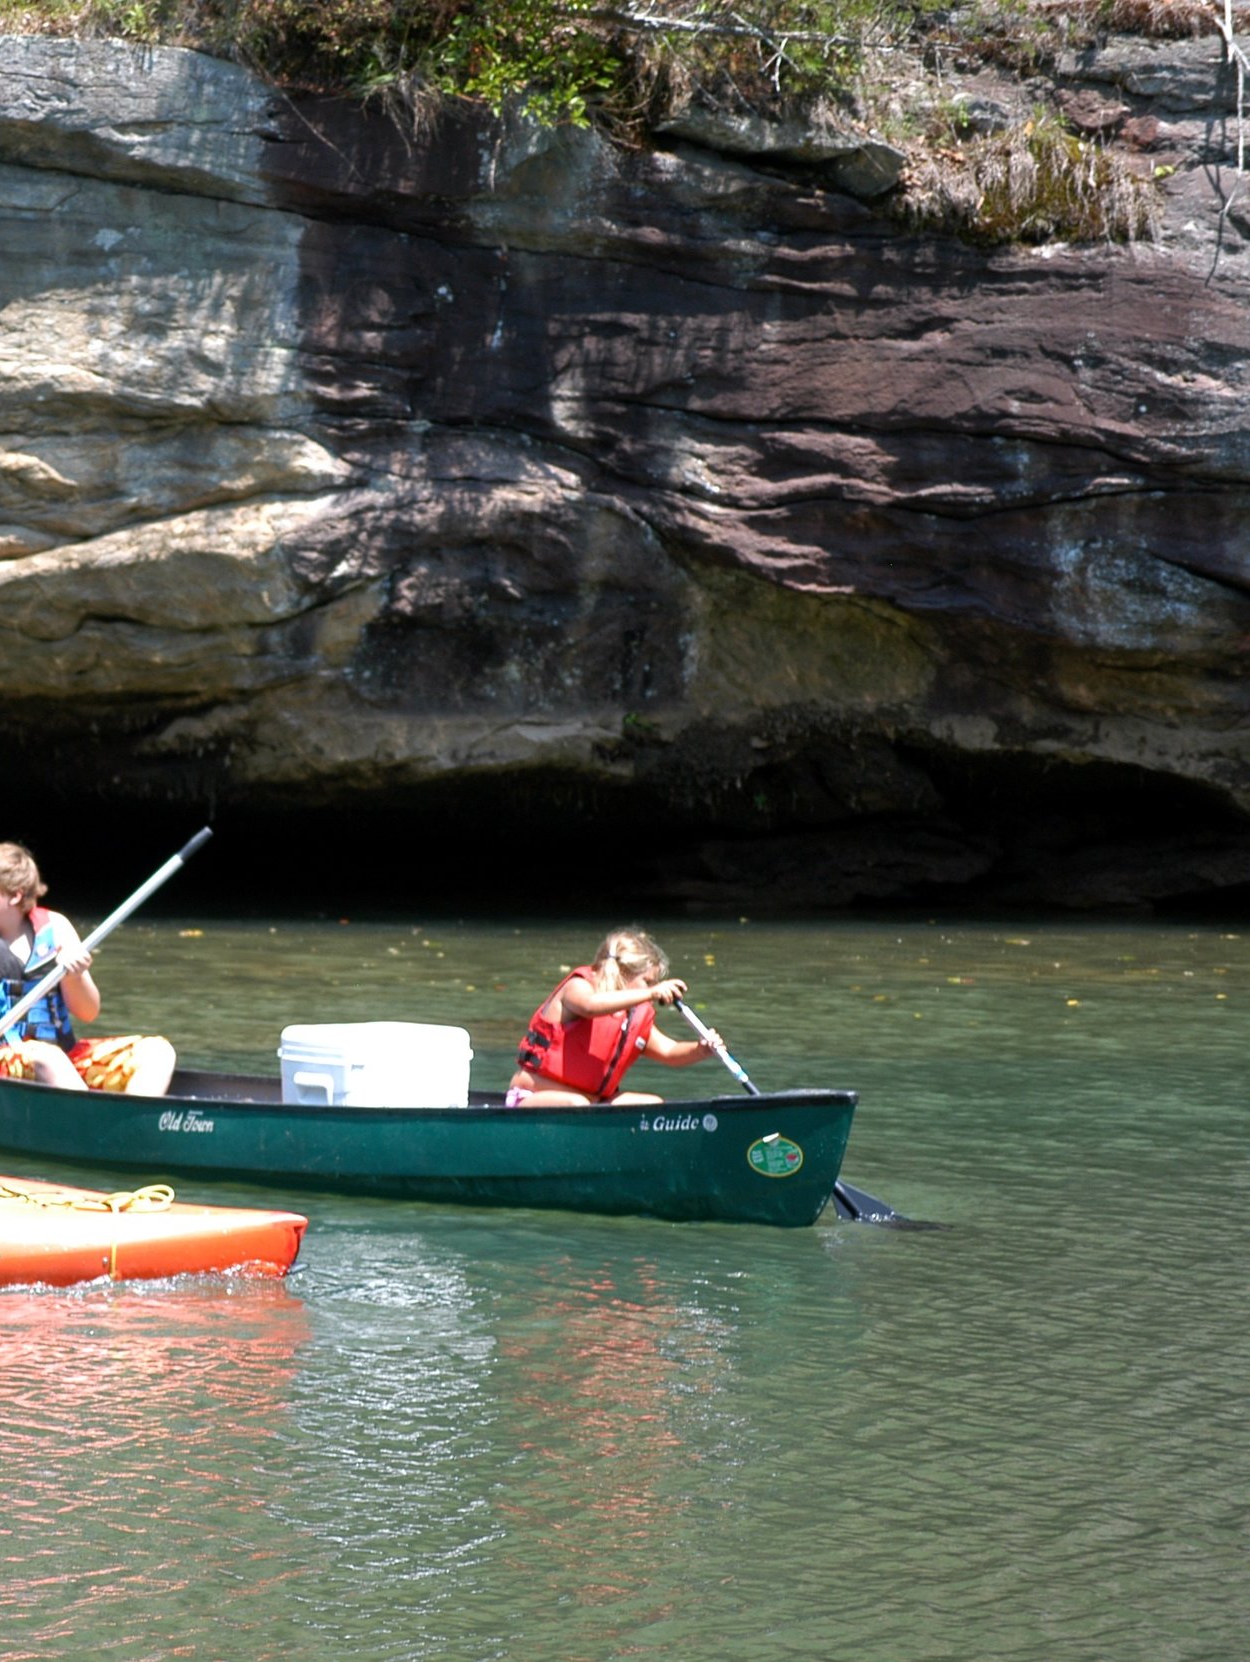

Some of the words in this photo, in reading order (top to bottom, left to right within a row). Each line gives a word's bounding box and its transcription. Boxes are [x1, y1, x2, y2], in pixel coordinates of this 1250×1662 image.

[158, 1109, 183, 1132] Old
[182, 1110, 214, 1133] Town
[652, 1114, 700, 1132] Guide
